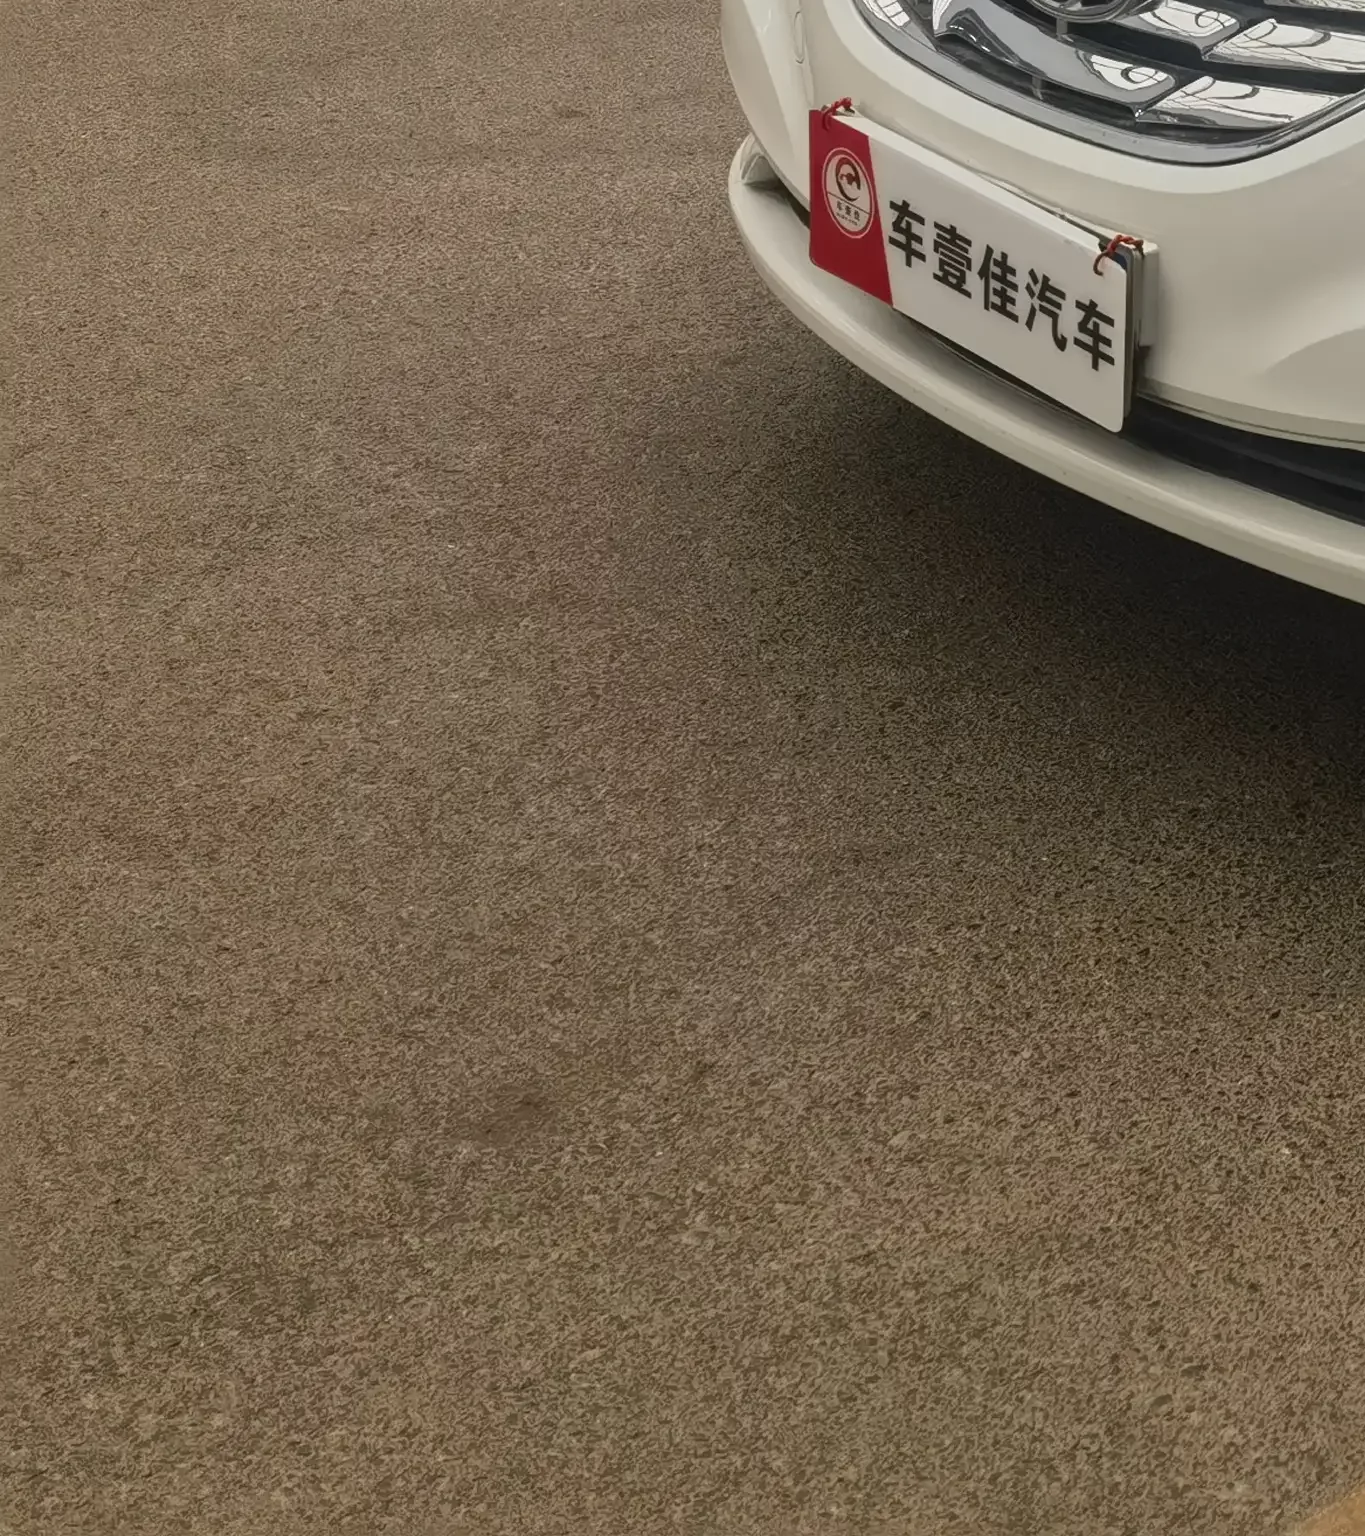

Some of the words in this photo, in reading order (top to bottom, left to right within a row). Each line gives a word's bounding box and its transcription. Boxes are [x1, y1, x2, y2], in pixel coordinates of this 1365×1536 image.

[889, 199, 1115, 371] 车壹佳汽车
